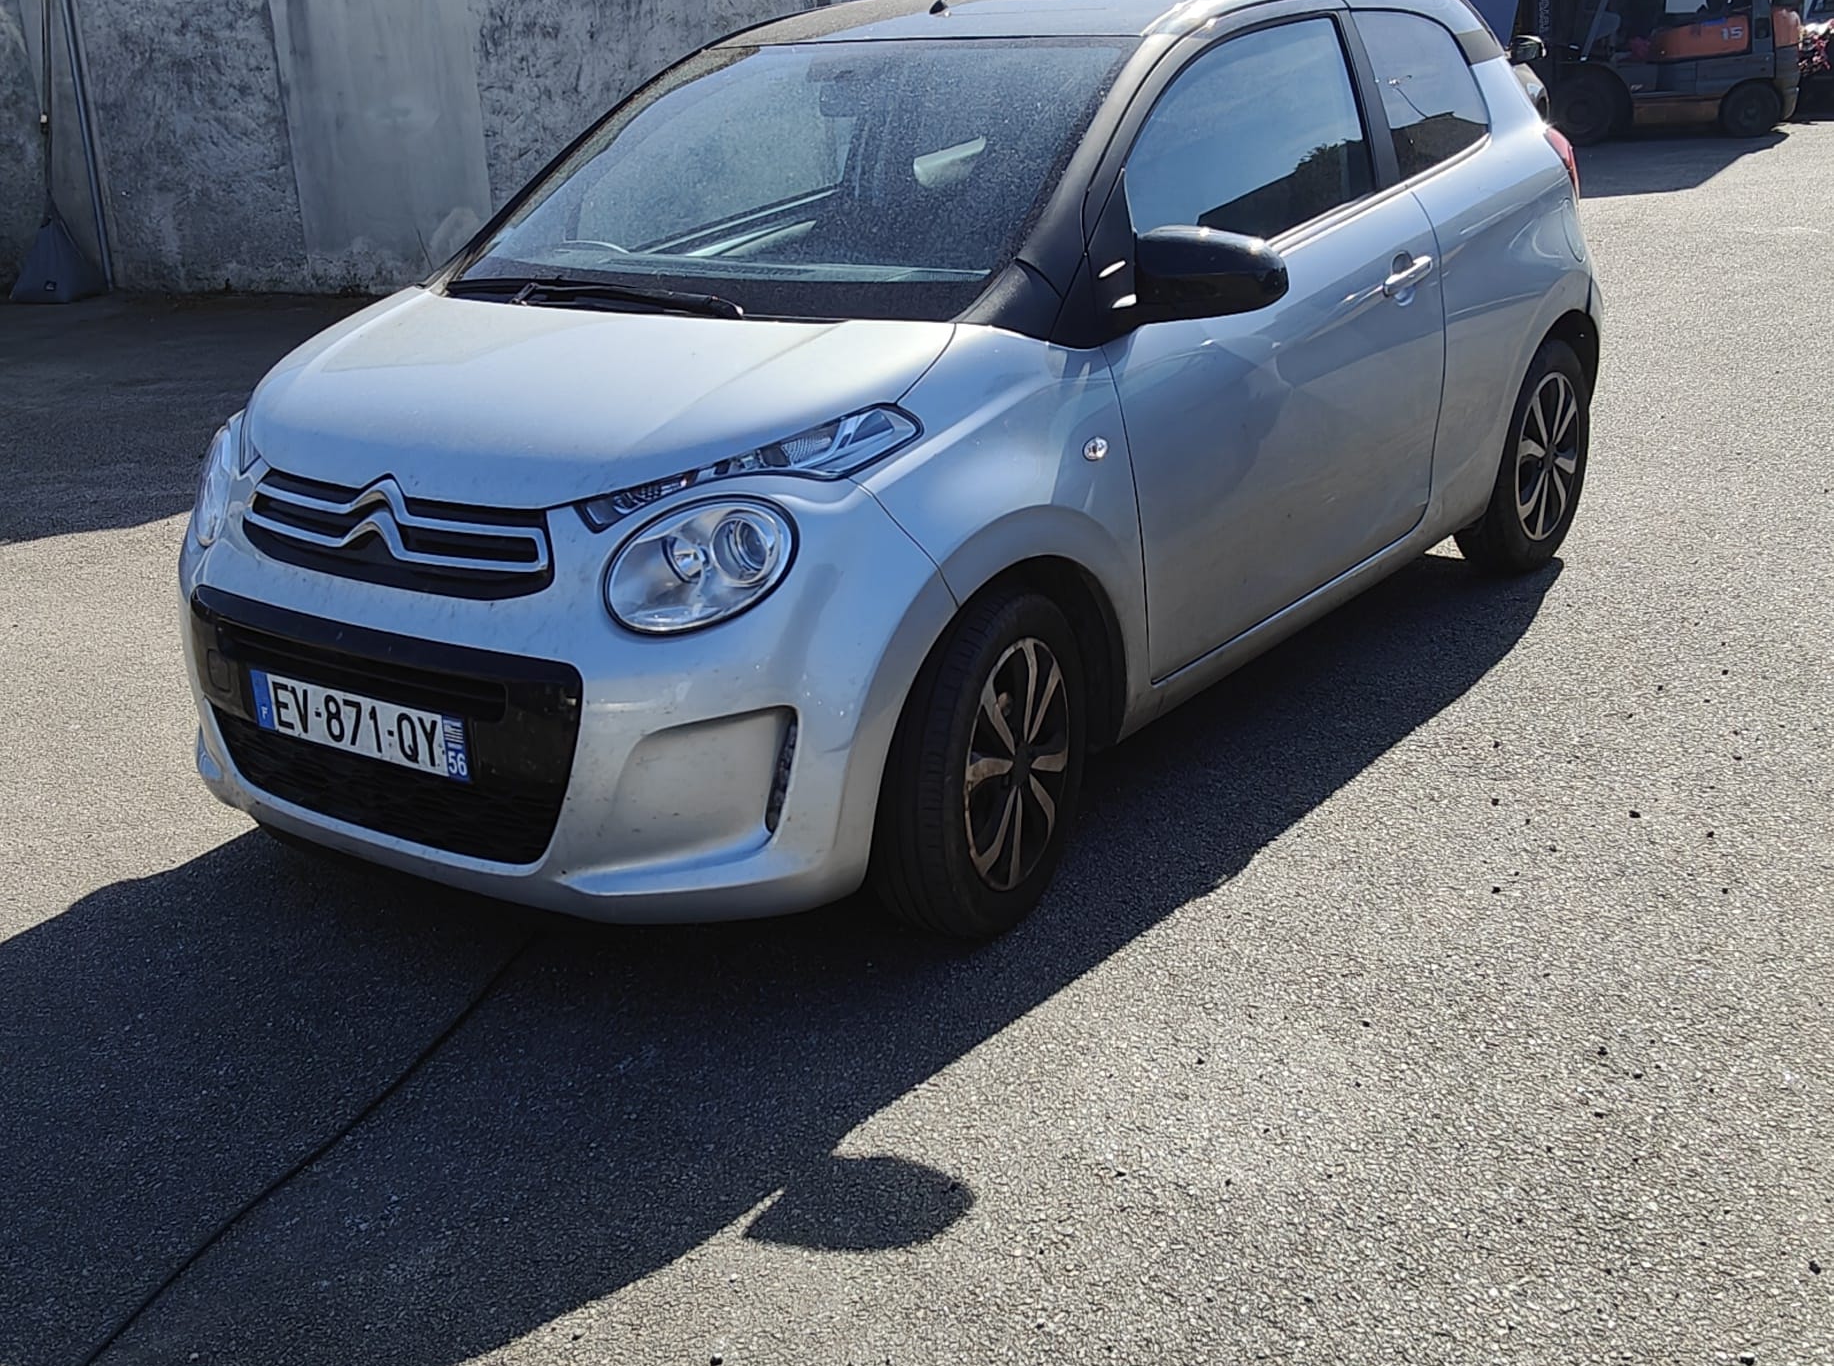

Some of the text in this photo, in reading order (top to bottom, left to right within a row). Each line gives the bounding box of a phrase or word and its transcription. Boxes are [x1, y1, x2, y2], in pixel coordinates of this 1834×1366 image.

[1721, 26, 1744, 41] 15
[261, 706, 268, 720] F
[271, 681, 438, 768] EV-871-QY
[447, 750, 468, 776] 56
